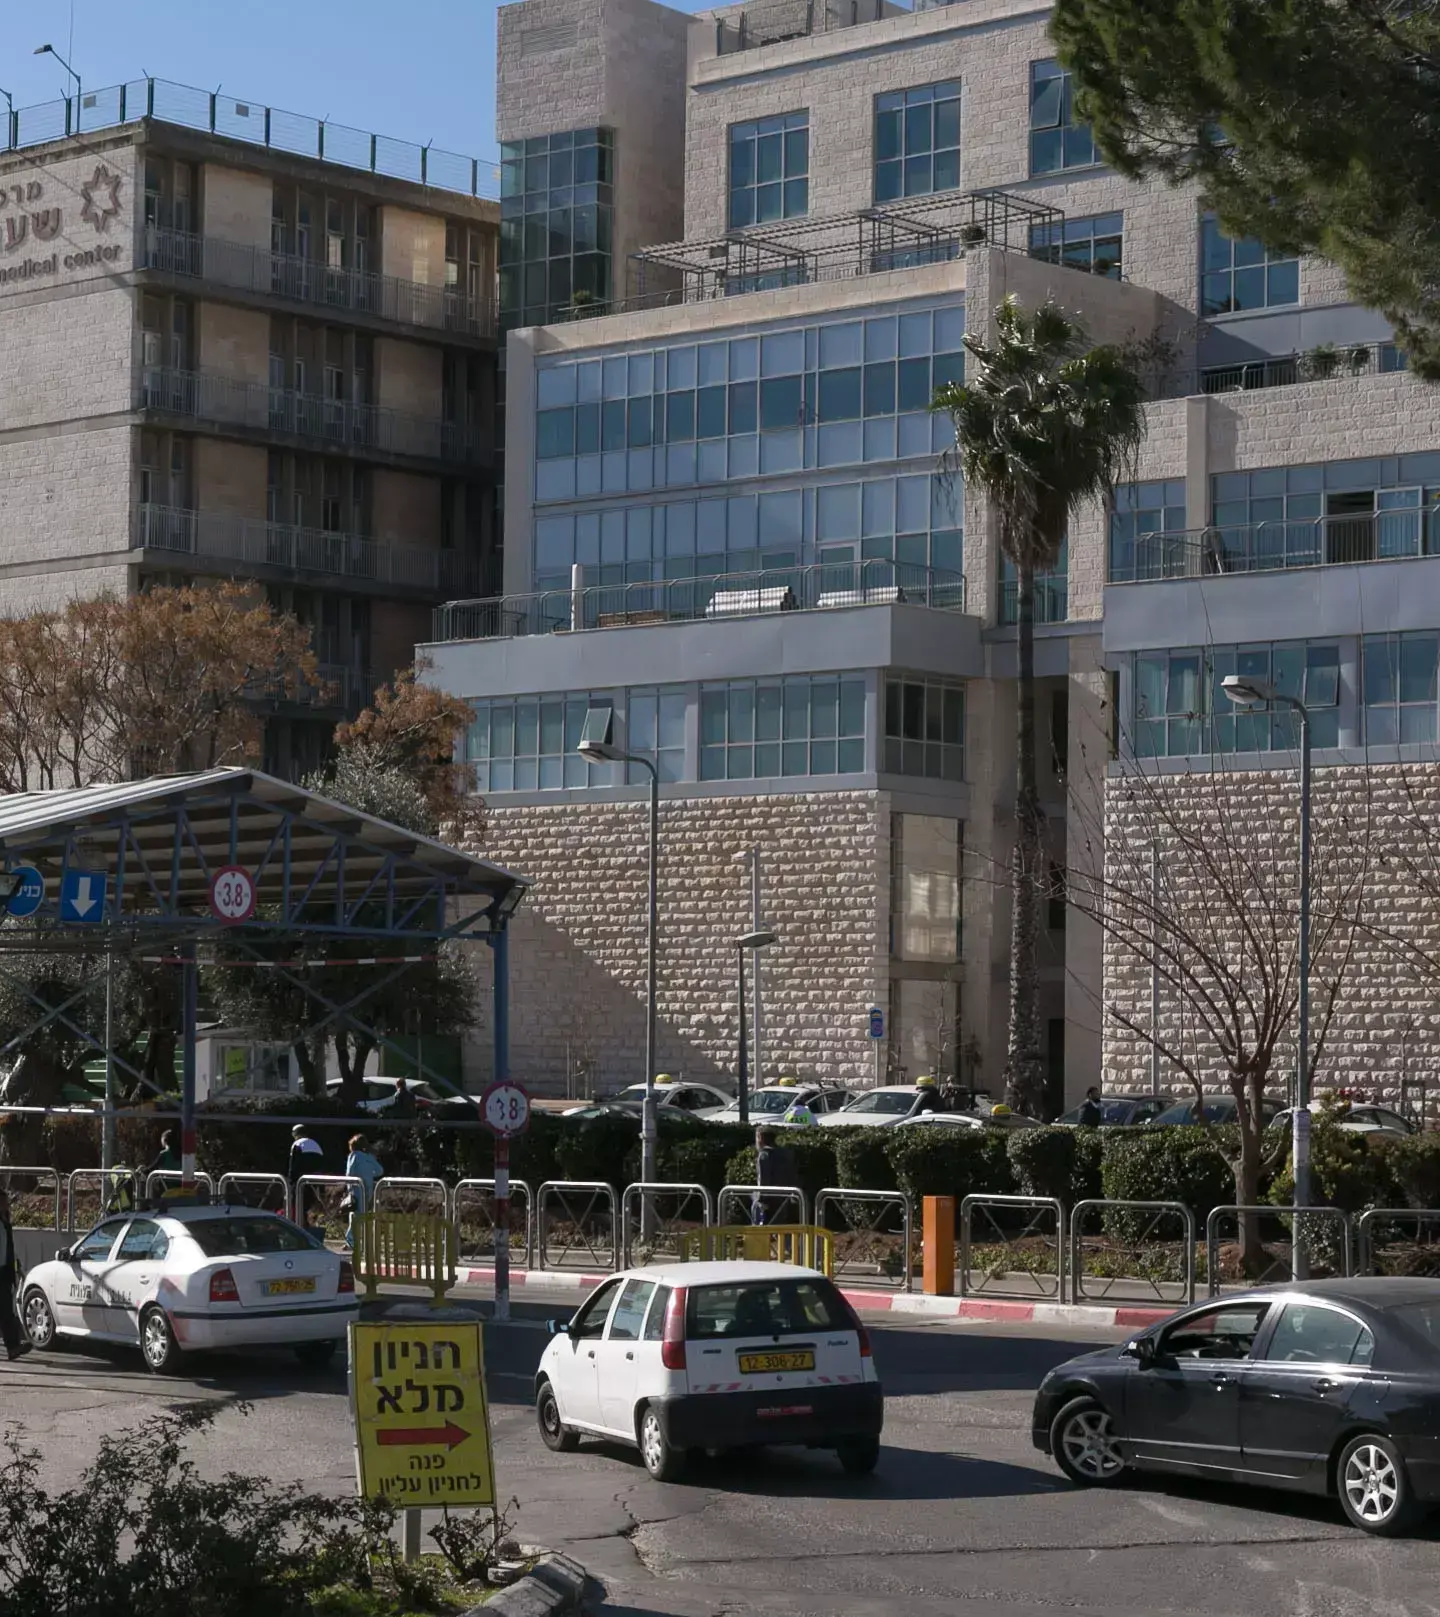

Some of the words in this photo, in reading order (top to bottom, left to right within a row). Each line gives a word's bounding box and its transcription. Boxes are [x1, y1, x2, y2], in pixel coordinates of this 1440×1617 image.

[64, 244, 121, 269] center
[222, 882, 243, 907] 3.8
[373, 1341, 461, 1378] חניון
[375, 1378, 465, 1414] מלא
[409, 1454, 446, 1470] פנה
[379, 1475, 422, 1495] עליון
[428, 1472, 481, 1496] לחניון
